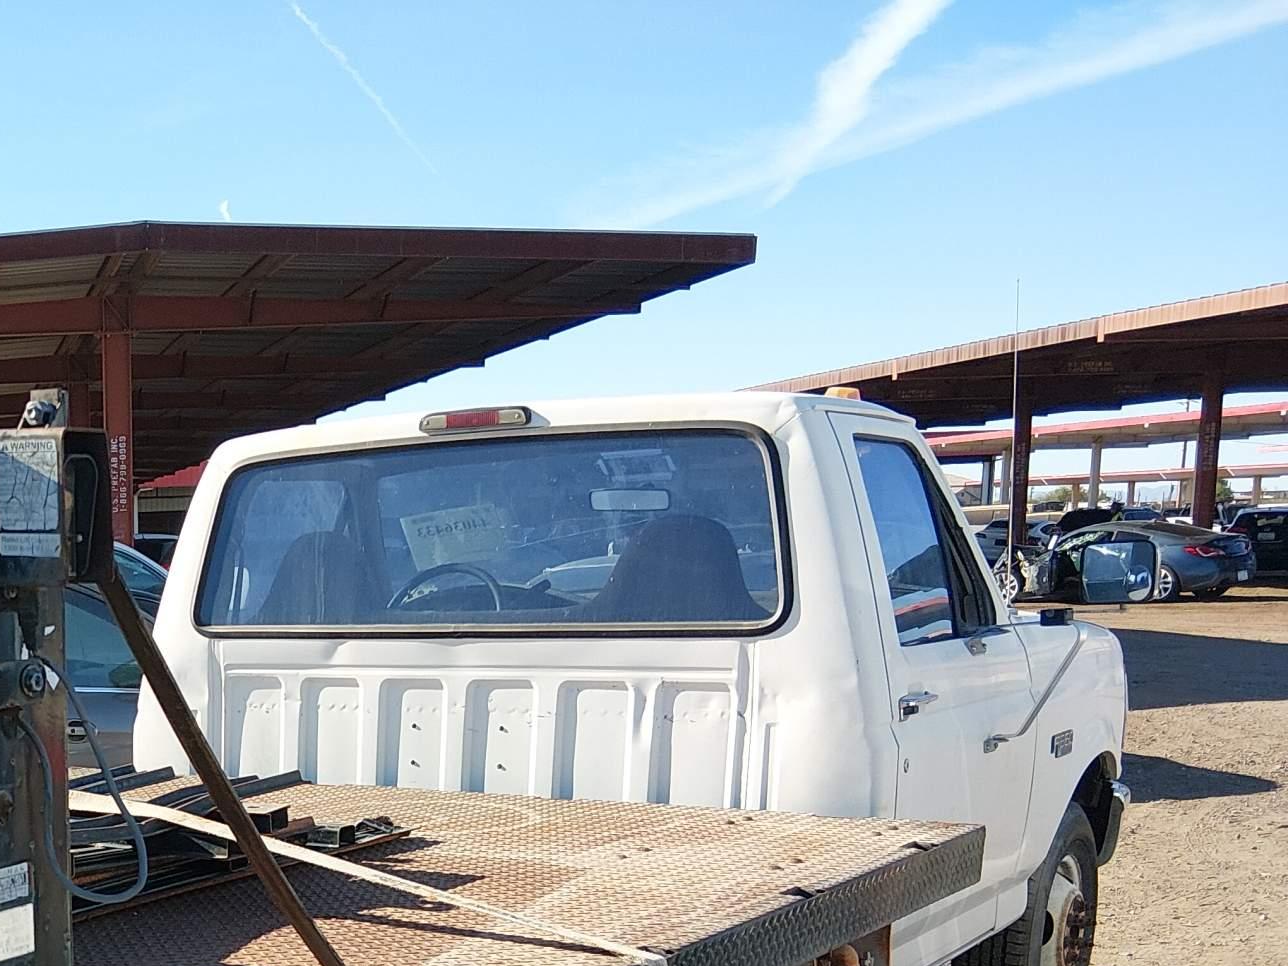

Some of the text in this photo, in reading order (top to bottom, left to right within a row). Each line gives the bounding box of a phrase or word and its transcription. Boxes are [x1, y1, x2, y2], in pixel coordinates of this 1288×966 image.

[10, 440, 53, 451] WARNING
[110, 435, 119, 453] INC.
[110, 457, 119, 492] PREFAB
